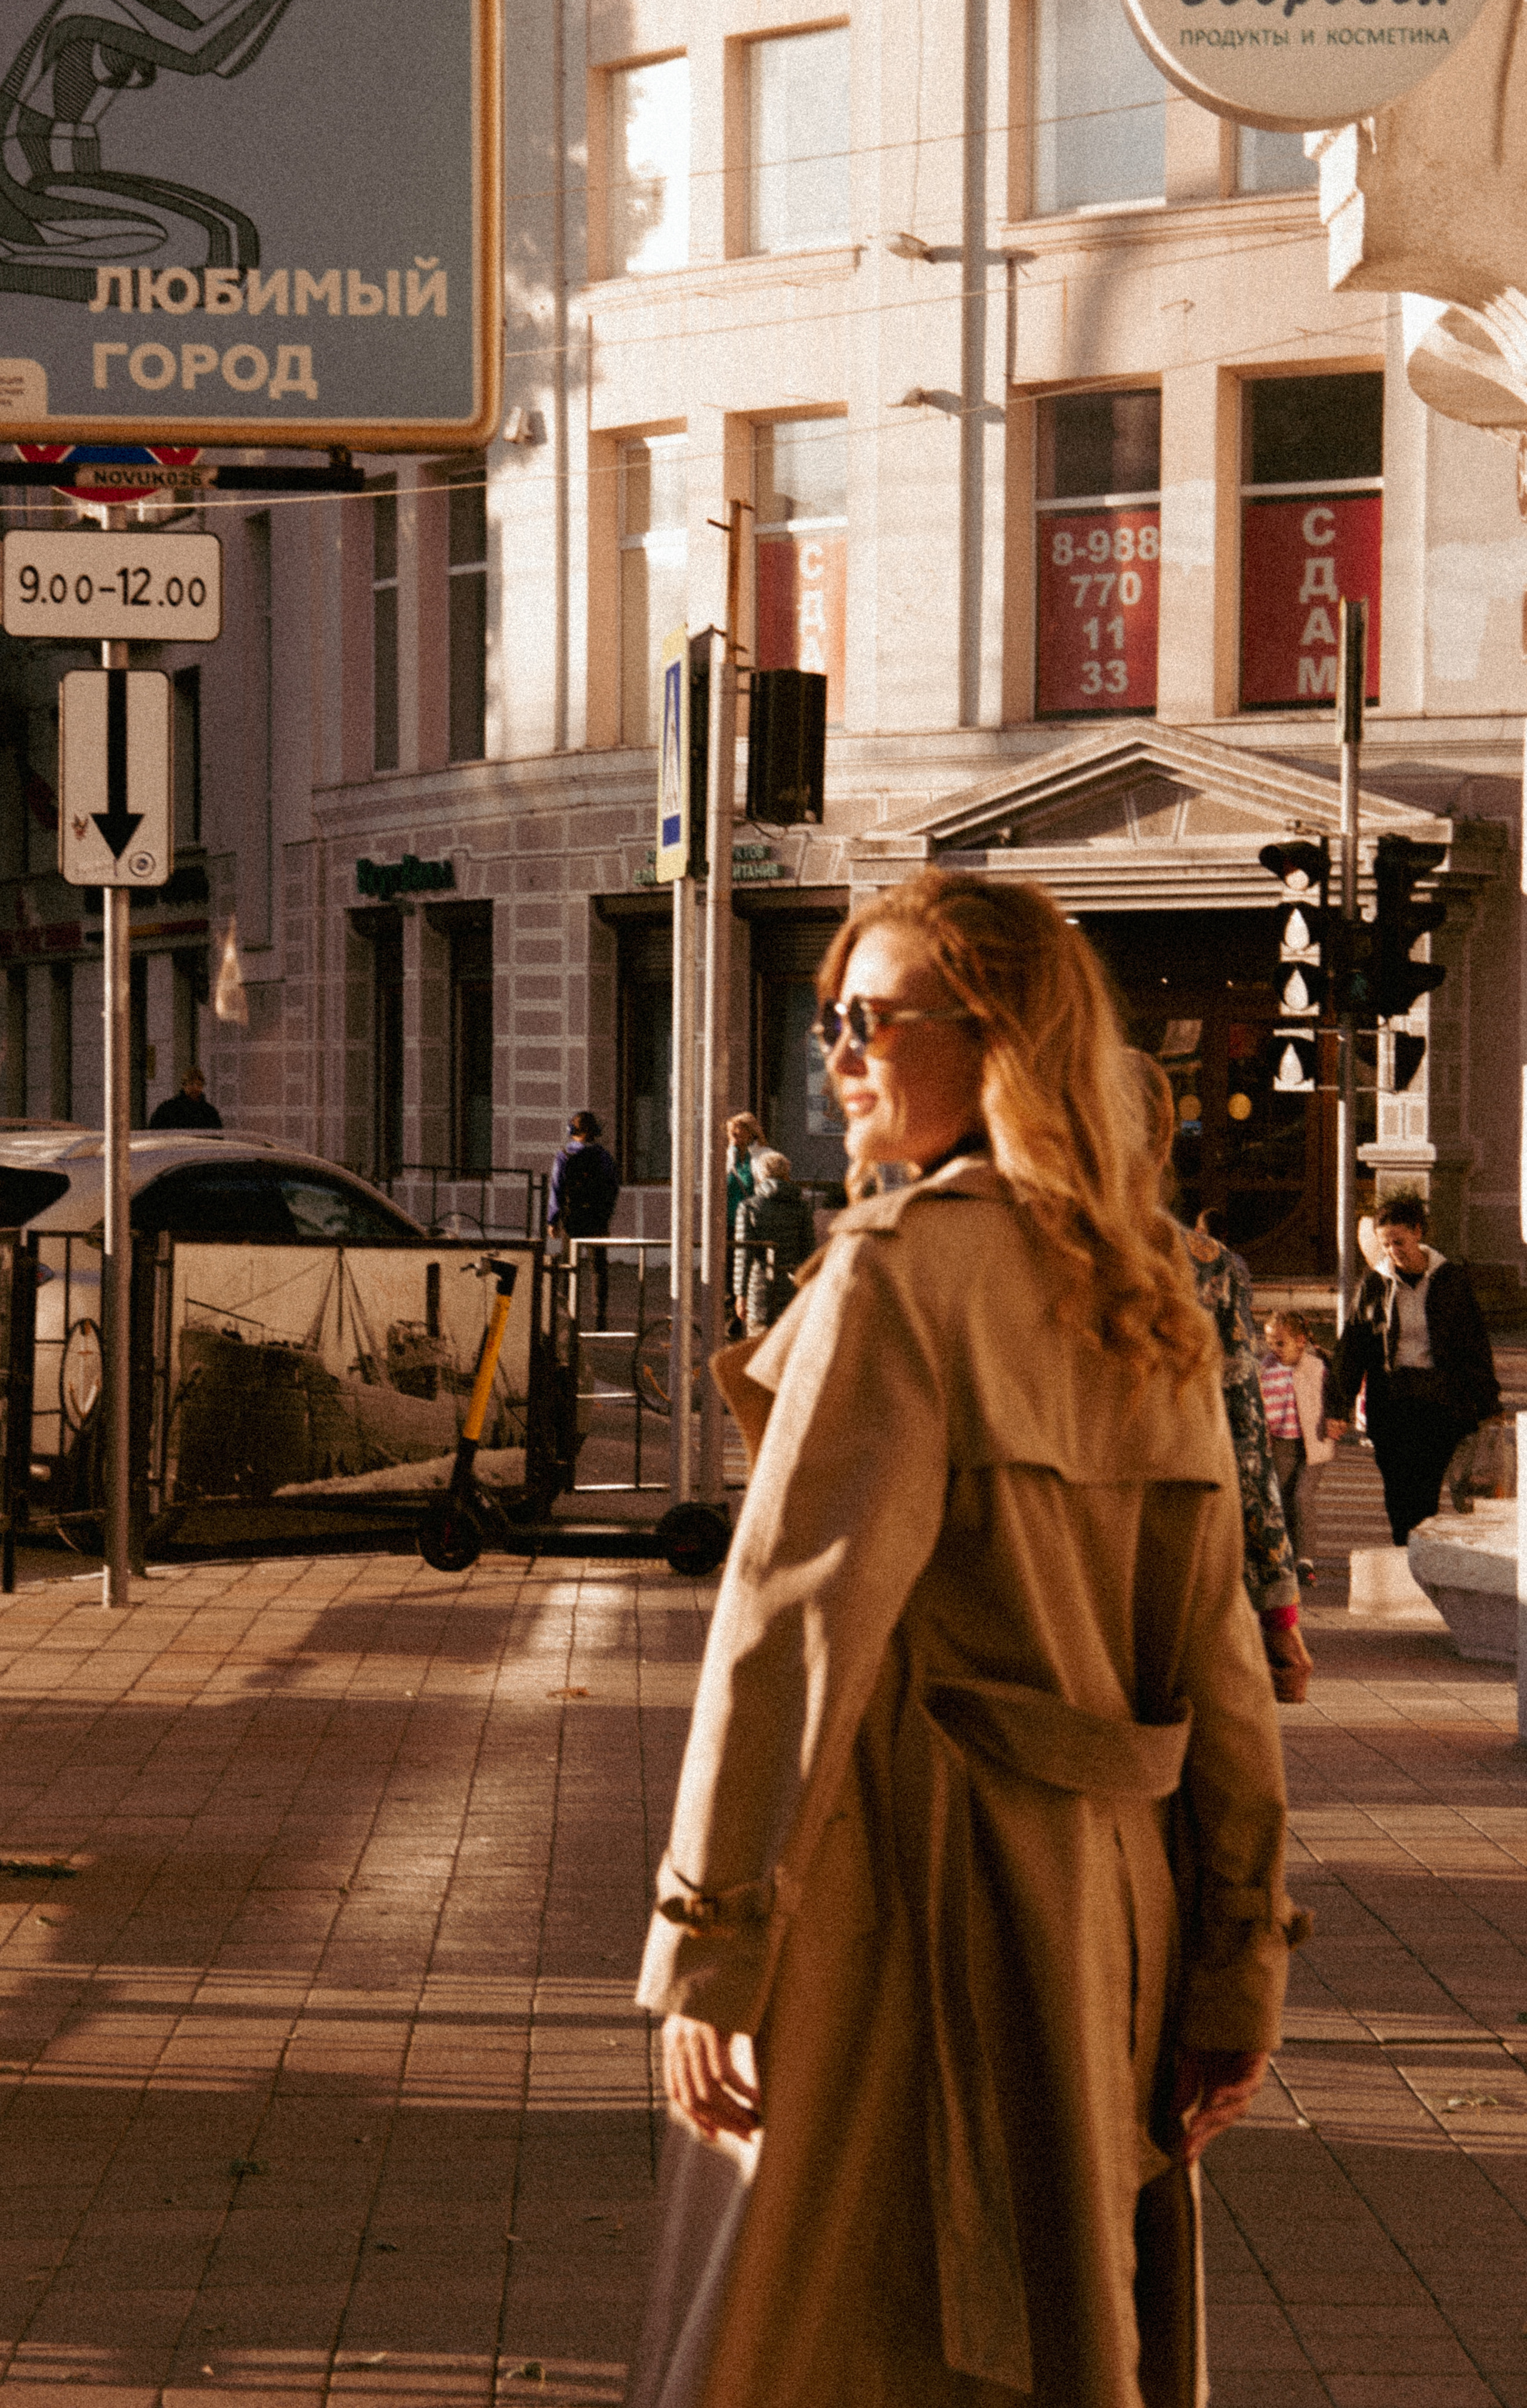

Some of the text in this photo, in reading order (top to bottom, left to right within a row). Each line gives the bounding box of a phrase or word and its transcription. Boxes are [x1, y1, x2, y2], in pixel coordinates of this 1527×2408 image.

[1179, 27, 1451, 49] ПРОДУКТЫ И КОСМЕТИКА
[89, 256, 448, 317] ЛЮБИМЫЙ
[92, 342, 319, 400] ГОРОД
[1052, 526, 1159, 565] 8-988
[1069, 571, 1142, 608] 770
[1297, 507, 1339, 695] СДАМ
[1082, 616, 1125, 651] 11
[1080, 660, 1128, 695] 33
